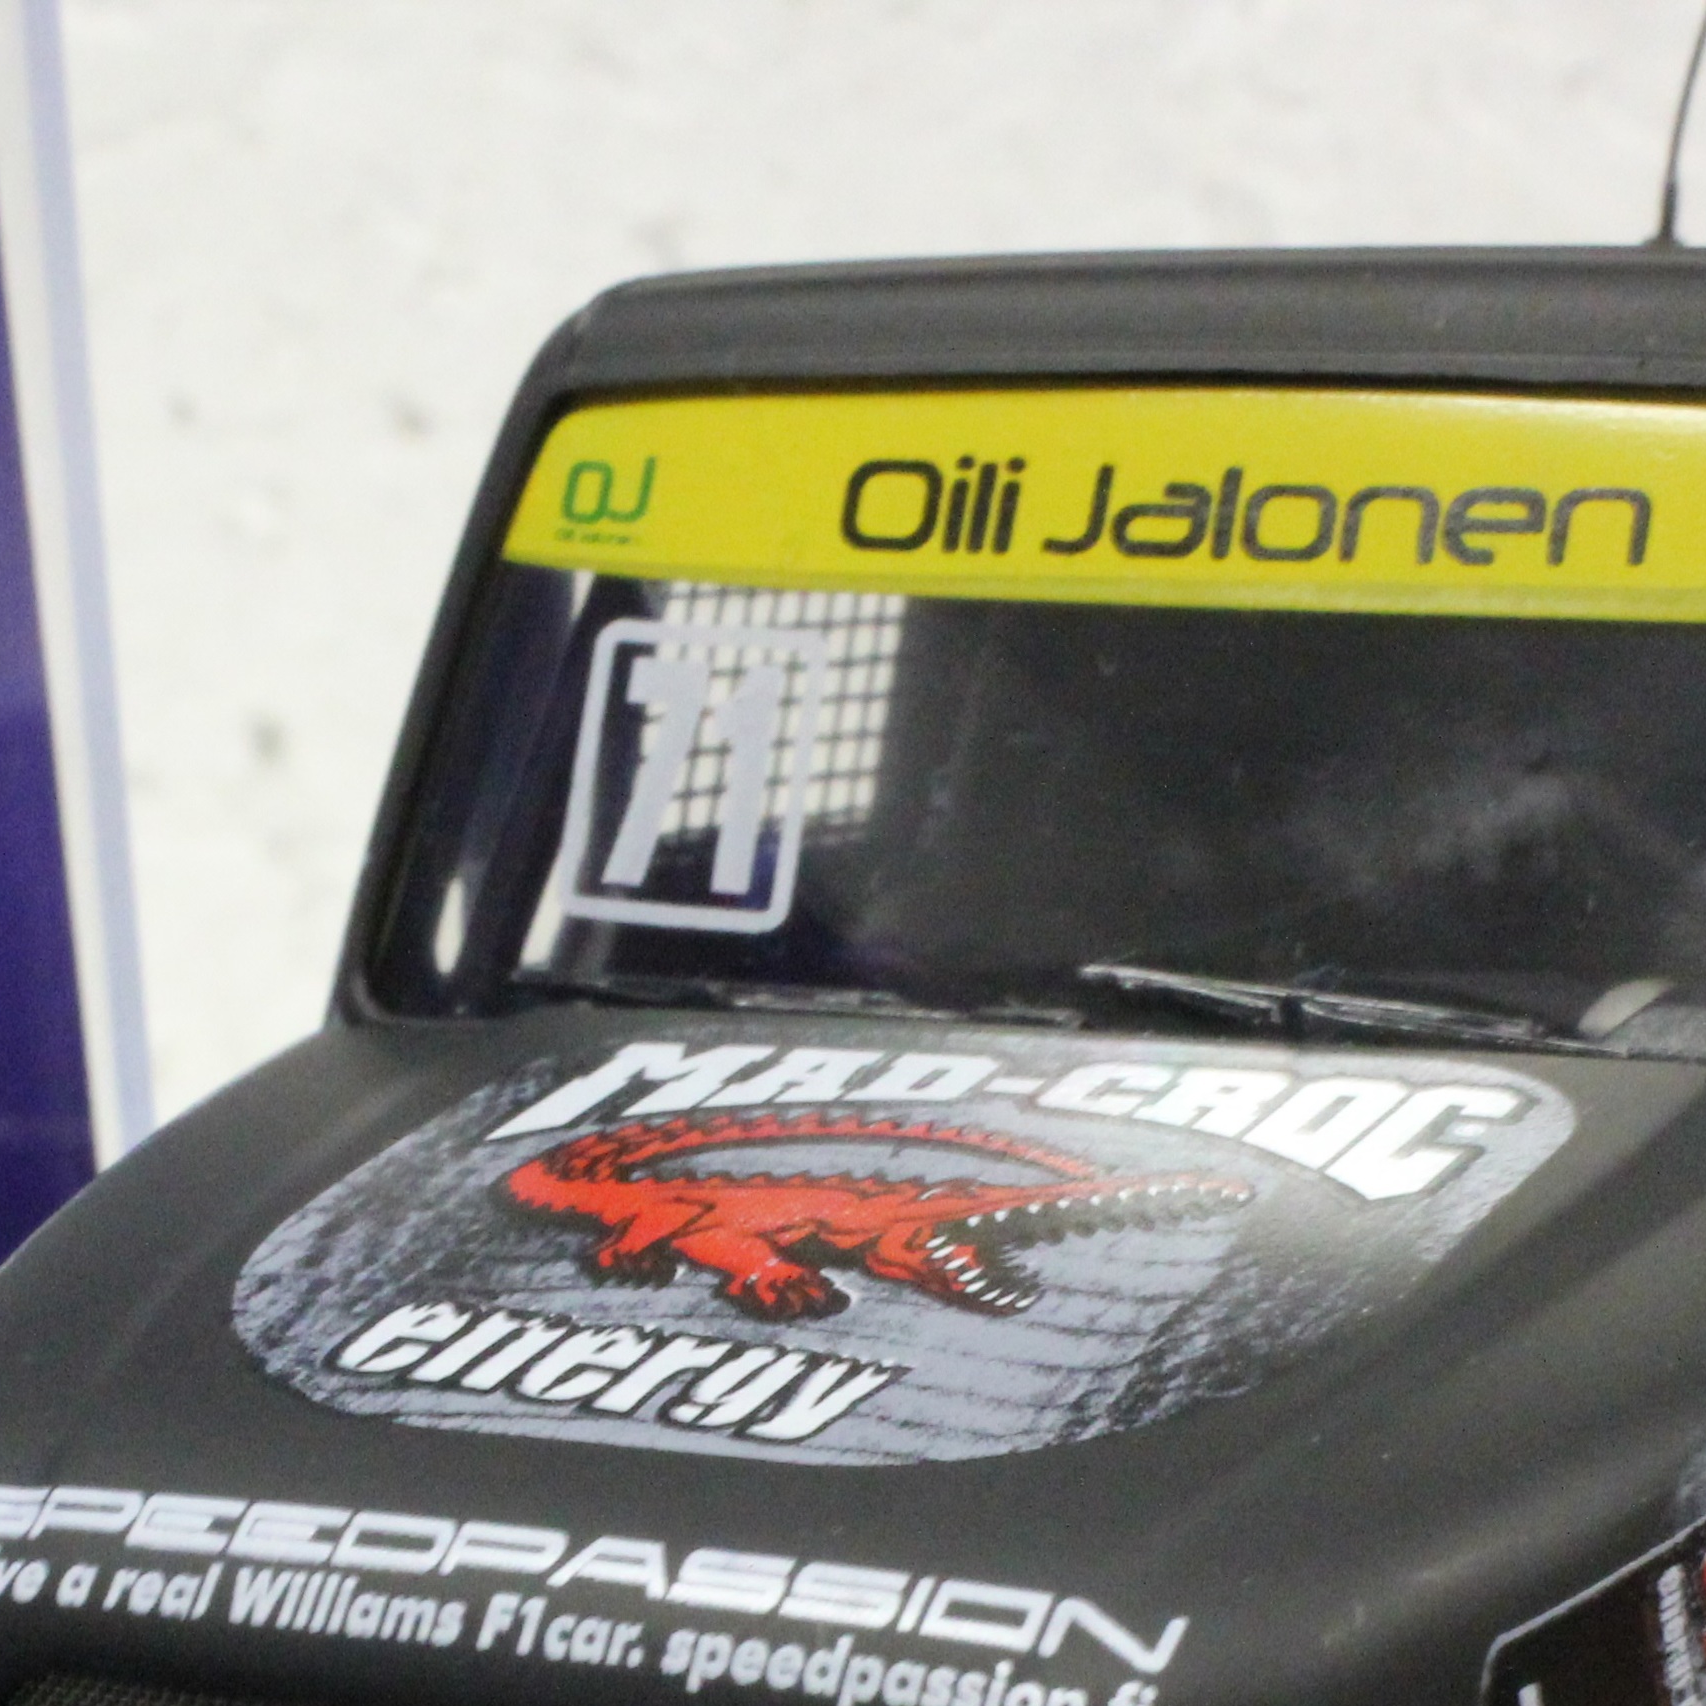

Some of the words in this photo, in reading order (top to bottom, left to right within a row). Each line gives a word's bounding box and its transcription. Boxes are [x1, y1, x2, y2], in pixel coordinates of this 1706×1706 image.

[560, 455, 657, 526] OJ
[840, 454, 1025, 554] Oili
[1043, 463, 1651, 567] Jalonen
[485, 1042, 1540, 1202] MAD-CROC
[332, 1301, 912, 1443] energy
[56, 1562, 97, 1606] a
[105, 1566, 209, 1624] real
[233, 1568, 463, 1650] Williams
